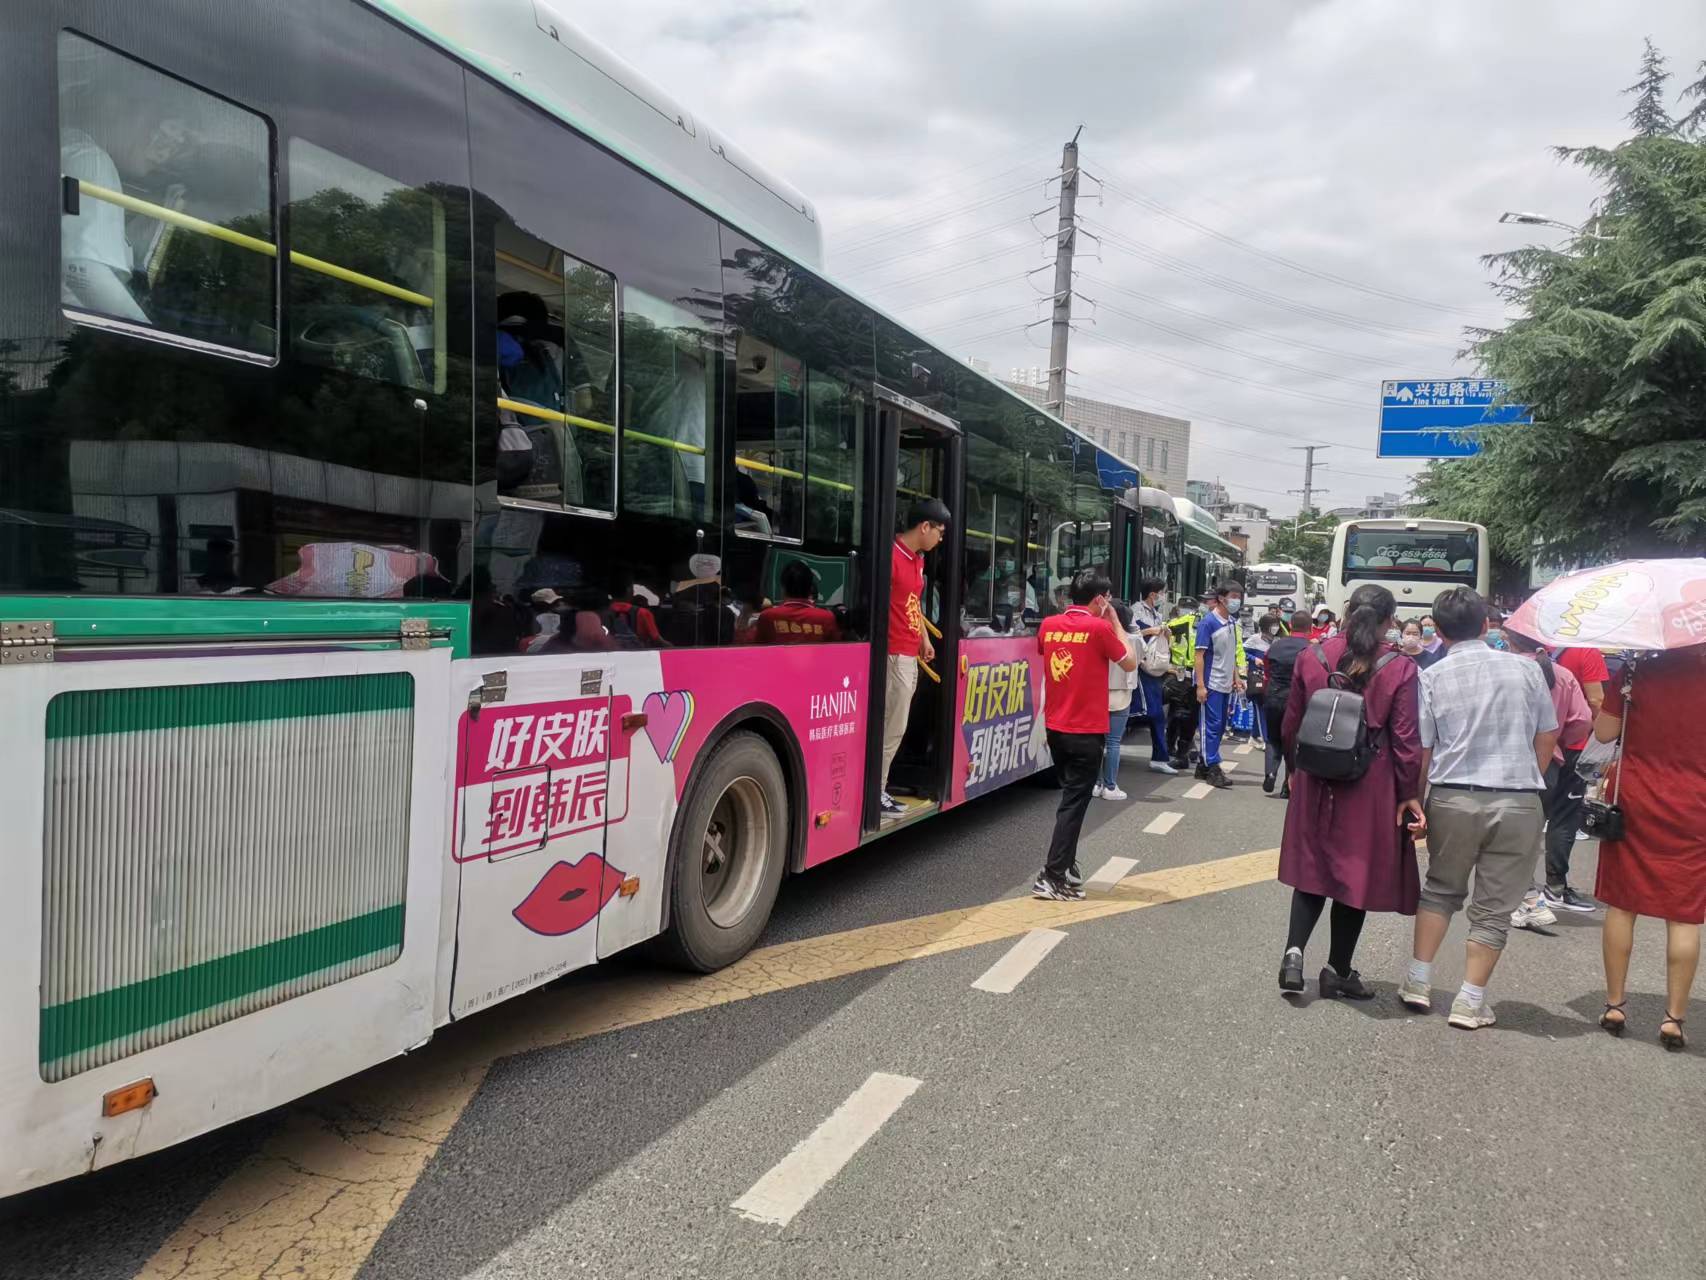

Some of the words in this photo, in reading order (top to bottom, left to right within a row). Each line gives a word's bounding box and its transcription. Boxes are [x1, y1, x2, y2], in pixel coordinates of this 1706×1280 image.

[1413, 397, 1429, 405] Xing
[1432, 397, 1450, 405] Yuan
[1454, 397, 1464, 405] Rd
[1414, 382, 1465, 397] 兴苑路
[810, 686, 857, 721] HANJIN
[962, 660, 1029, 726] 好皮肤
[484, 706, 609, 772] 好皮肤
[964, 714, 1032, 788] 到韩辰
[481, 770, 607, 844] 到韩辰
